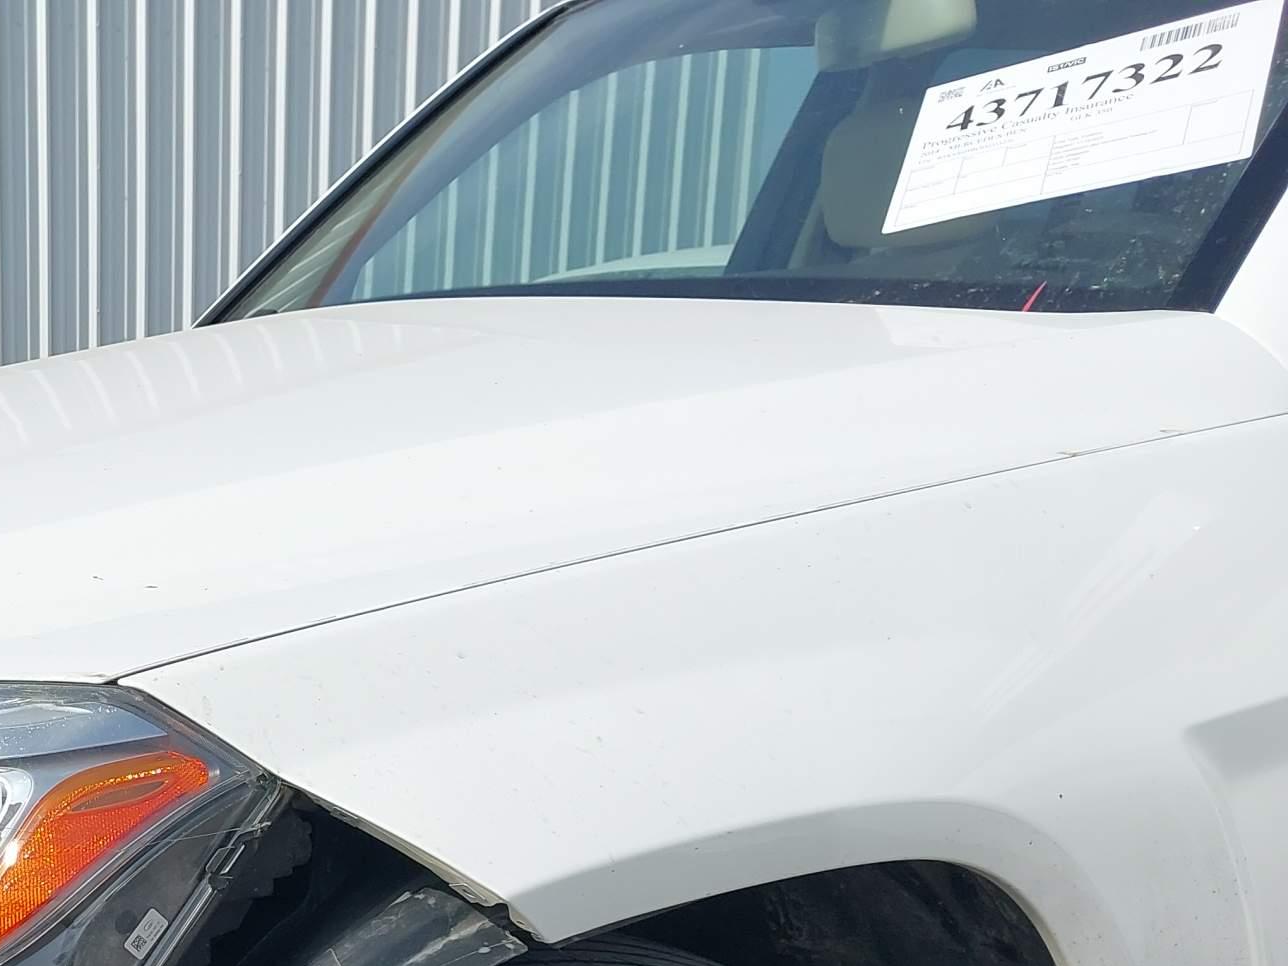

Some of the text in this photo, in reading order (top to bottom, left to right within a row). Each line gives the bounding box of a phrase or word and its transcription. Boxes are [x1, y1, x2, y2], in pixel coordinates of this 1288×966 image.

[922, 92, 1135, 150] Progressive Casualty Insurance
[946, 43, 1223, 131] 43717322
